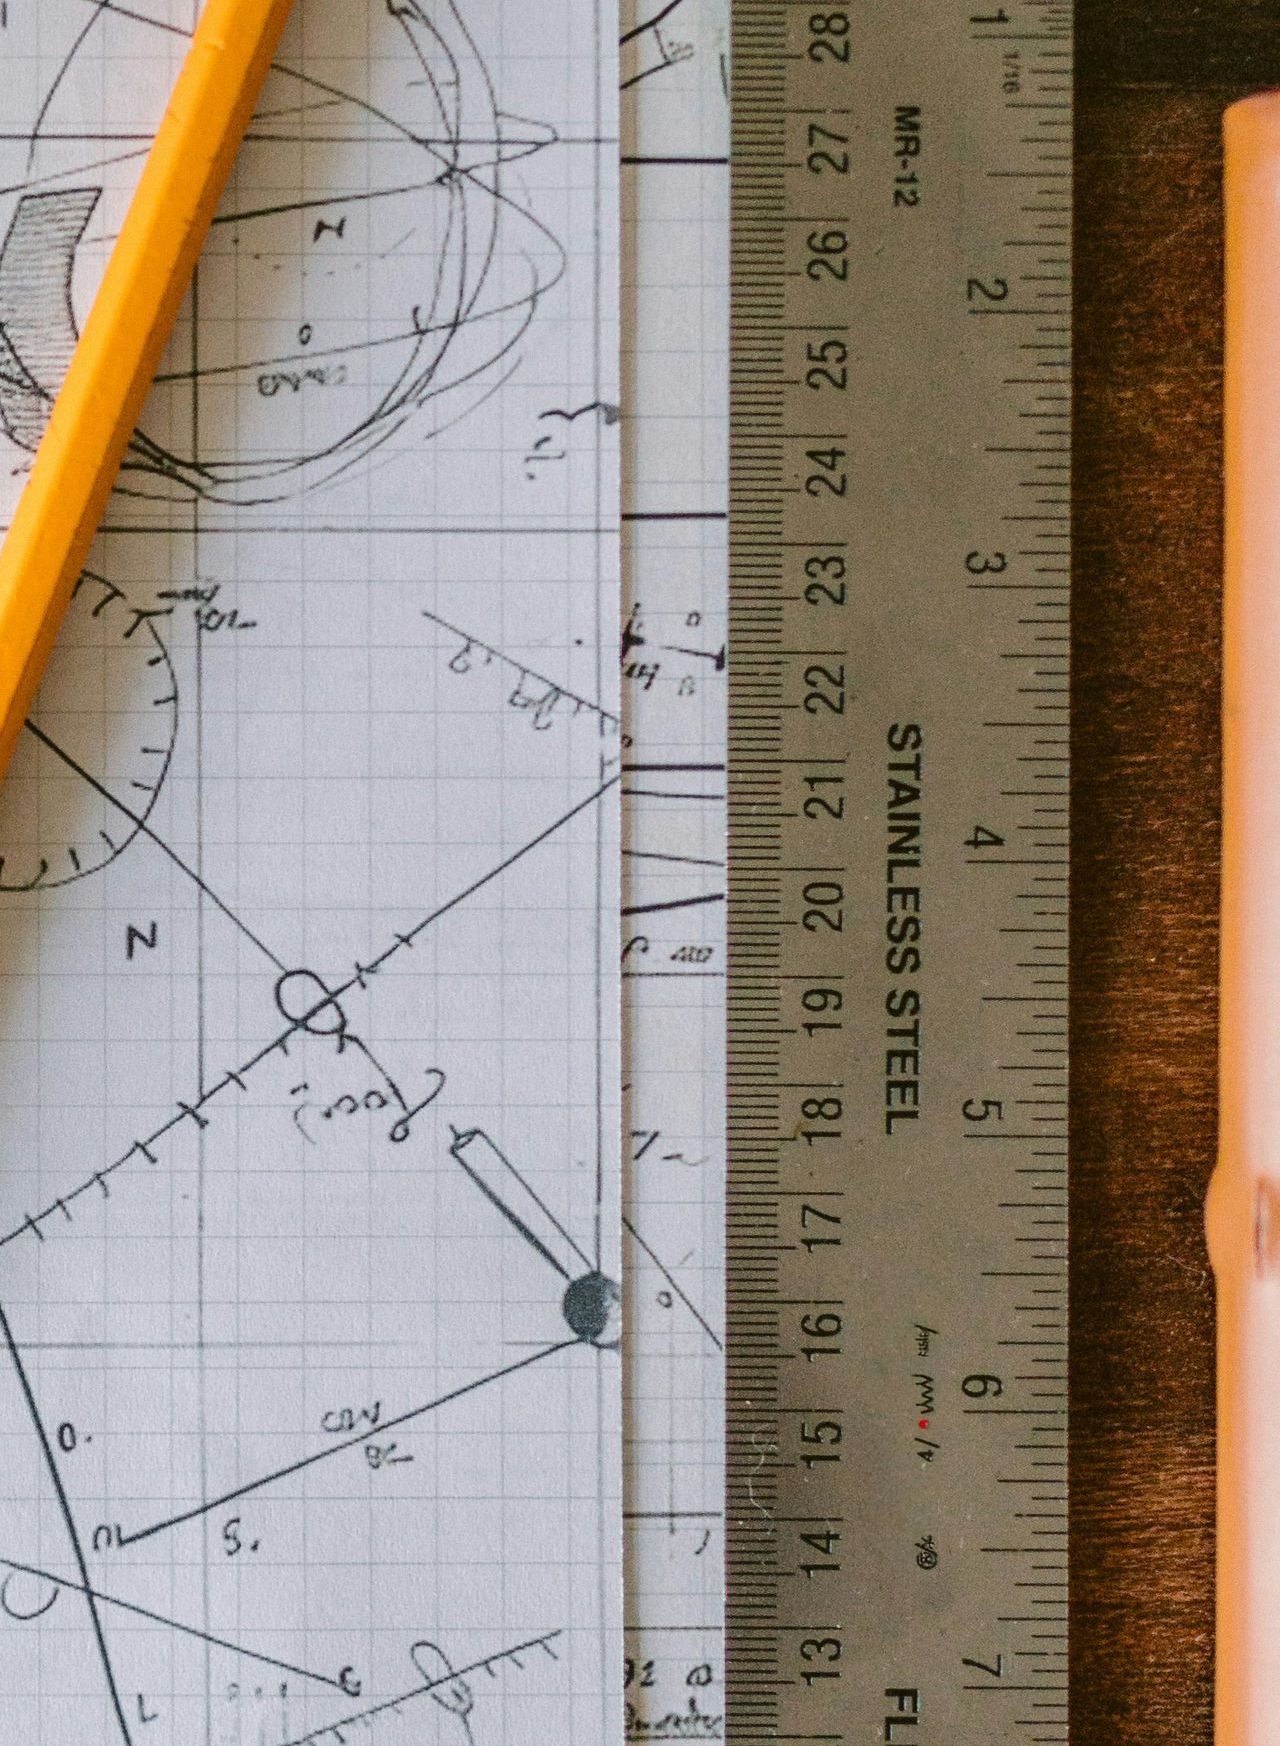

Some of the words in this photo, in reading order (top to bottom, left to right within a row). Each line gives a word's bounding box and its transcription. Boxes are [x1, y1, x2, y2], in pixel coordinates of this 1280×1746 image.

[808, 12, 850, 63] 28
[970, 8, 1009, 24] 1
[807, 123, 849, 176] 27
[893, 105, 922, 208] MR-12
[806, 230, 848, 282] 26
[967, 277, 1009, 302] 2
[805, 339, 848, 391] 25
[803, 446, 847, 498] 24
[803, 555, 846, 606] 23
[965, 550, 1008, 575] 3
[799, 664, 844, 715] 22
[799, 776, 844, 820] 21
[885, 722, 923, 975] STAINLESS
[963, 824, 1006, 850] 4
[799, 881, 844, 933] 20
[799, 988, 842, 1038] 19
[885, 989, 921, 1136] STEEL
[799, 1097, 842, 1147] 18
[961, 1097, 1004, 1123] 5
[799, 1203, 841, 1254] 17
[799, 1313, 841, 1363] 16
[961, 1373, 1004, 1398] 6
[799, 1421, 841, 1470] 15
[799, 1530, 841, 1579] 14
[799, 1637, 841, 1687] 13
[961, 1653, 1003, 1679] 7
